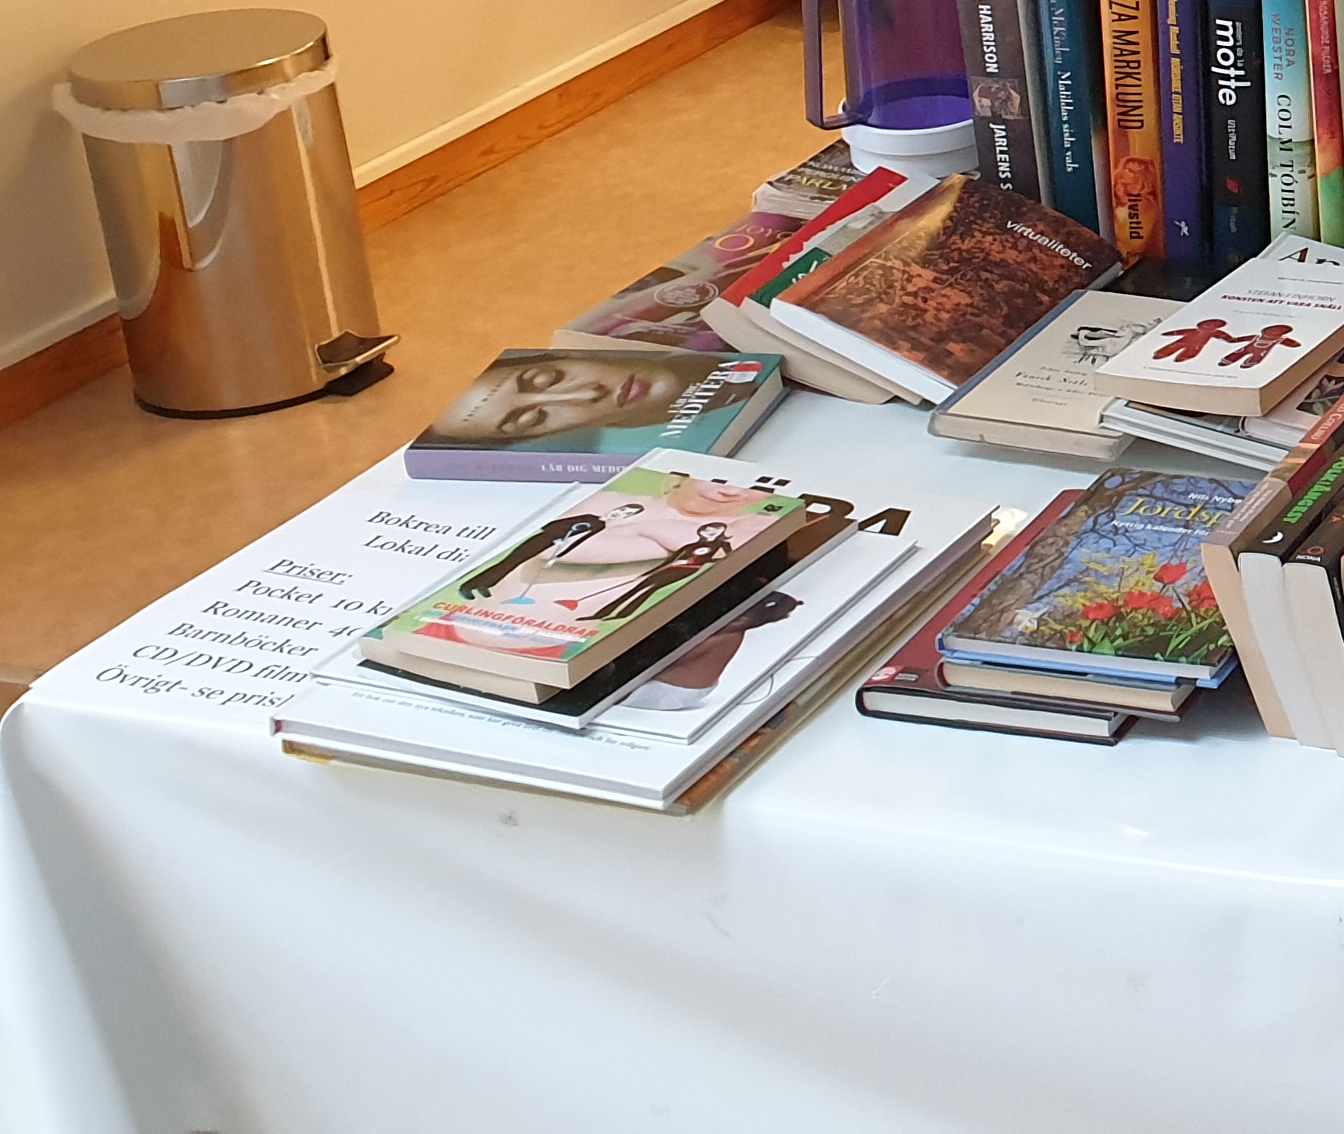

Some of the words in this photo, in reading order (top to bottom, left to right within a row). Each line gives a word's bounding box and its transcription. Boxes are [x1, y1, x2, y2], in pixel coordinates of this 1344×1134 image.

[978, 3, 999, 73] HARRISON
[1271, 13, 1284, 81] WEBSTER
[1285, 27, 1296, 68] NORA
[1112, 29, 1144, 130] MARKLUND
[1211, 18, 1251, 106] motte
[1058, 72, 1074, 121] Matildas
[1063, 123, 1076, 148] sista
[1276, 93, 1293, 153] COLM
[989, 123, 1012, 179] JARLENS
[1066, 150, 1079, 173] vals
[1280, 161, 1299, 232] TÓIBÍN
[1127, 192, 1144, 240] livstid
[366, 511, 453, 538] Bokrea
[456, 524, 497, 541] till
[362, 534, 434, 558] Lokal
[267, 558, 354, 586] Priser:
[234, 579, 324, 605] Pocket
[329, 597, 364, 614] 10
[201, 600, 324, 632] Romaner
[167, 622, 319, 657] Barnböcker
[131, 644, 253, 675] CD/DVD
[96, 664, 190, 696] Övrigt-
[192, 683, 219, 698] se
